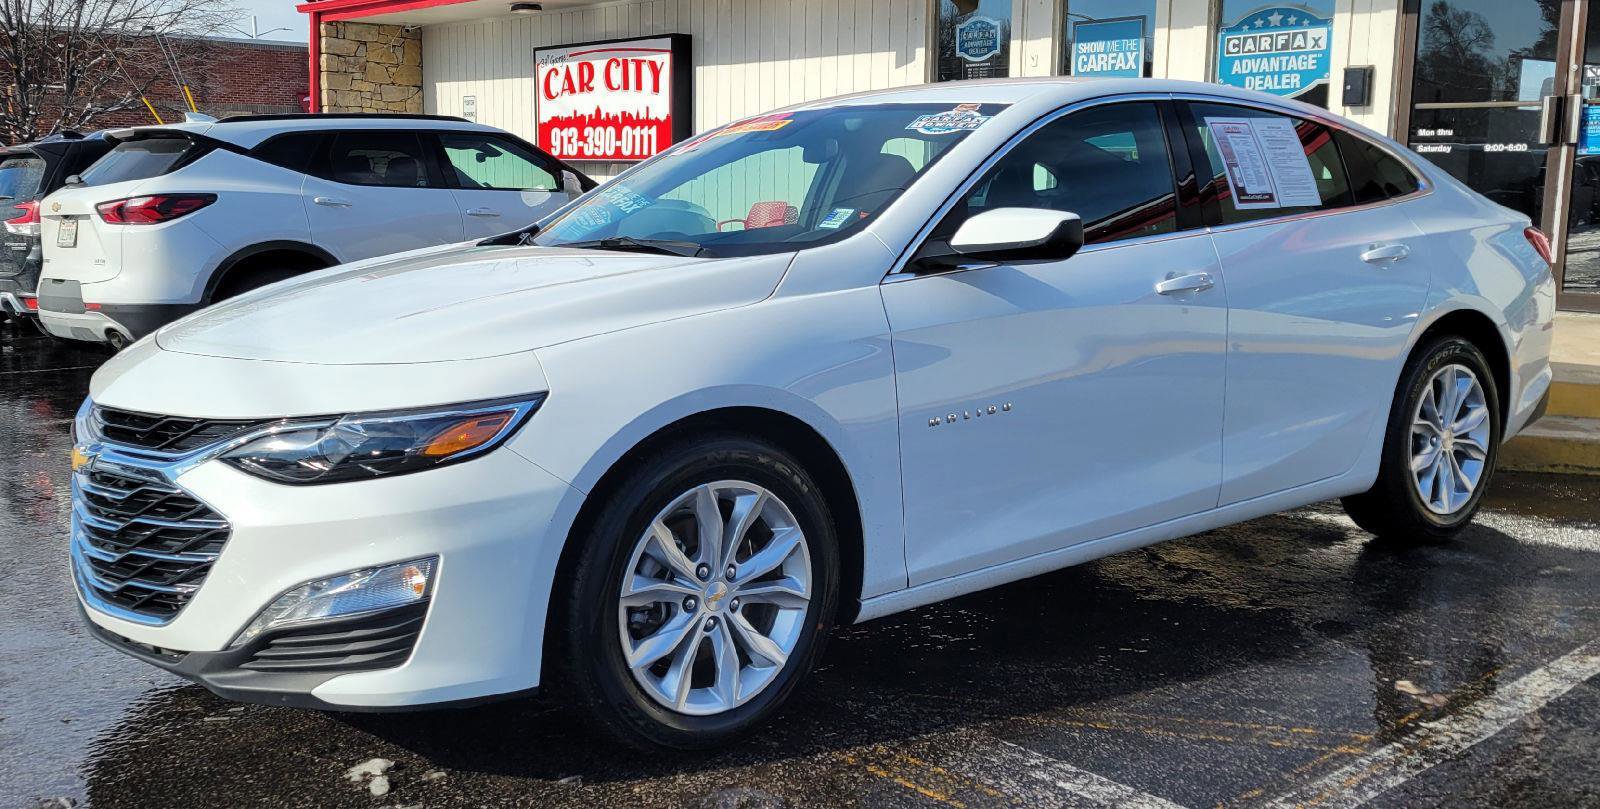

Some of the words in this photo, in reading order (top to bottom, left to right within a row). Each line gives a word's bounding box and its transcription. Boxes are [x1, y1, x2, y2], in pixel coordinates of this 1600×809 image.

[963, 30, 996, 40] CARFAX
[1078, 40, 1105, 54] SHOW
[1107, 39, 1120, 52] ME
[1122, 38, 1138, 51] THE
[1226, 32, 1324, 54] CARFAX
[1077, 51, 1137, 73] CARFAX
[1231, 53, 1318, 75] ADVANTAGE
[543, 61, 595, 101] CAR
[603, 57, 664, 96] CITY
[1245, 73, 1301, 91] DEALER
[551, 125, 657, 157] 913-390-0111
[1417, 128, 1435, 137] Mon
[1437, 128, 1454, 136] thru
[1416, 144, 1452, 154] Saturday
[1483, 143, 1528, 152] 9:00-6:00
[928, 402, 1012, 427] MALIBU
